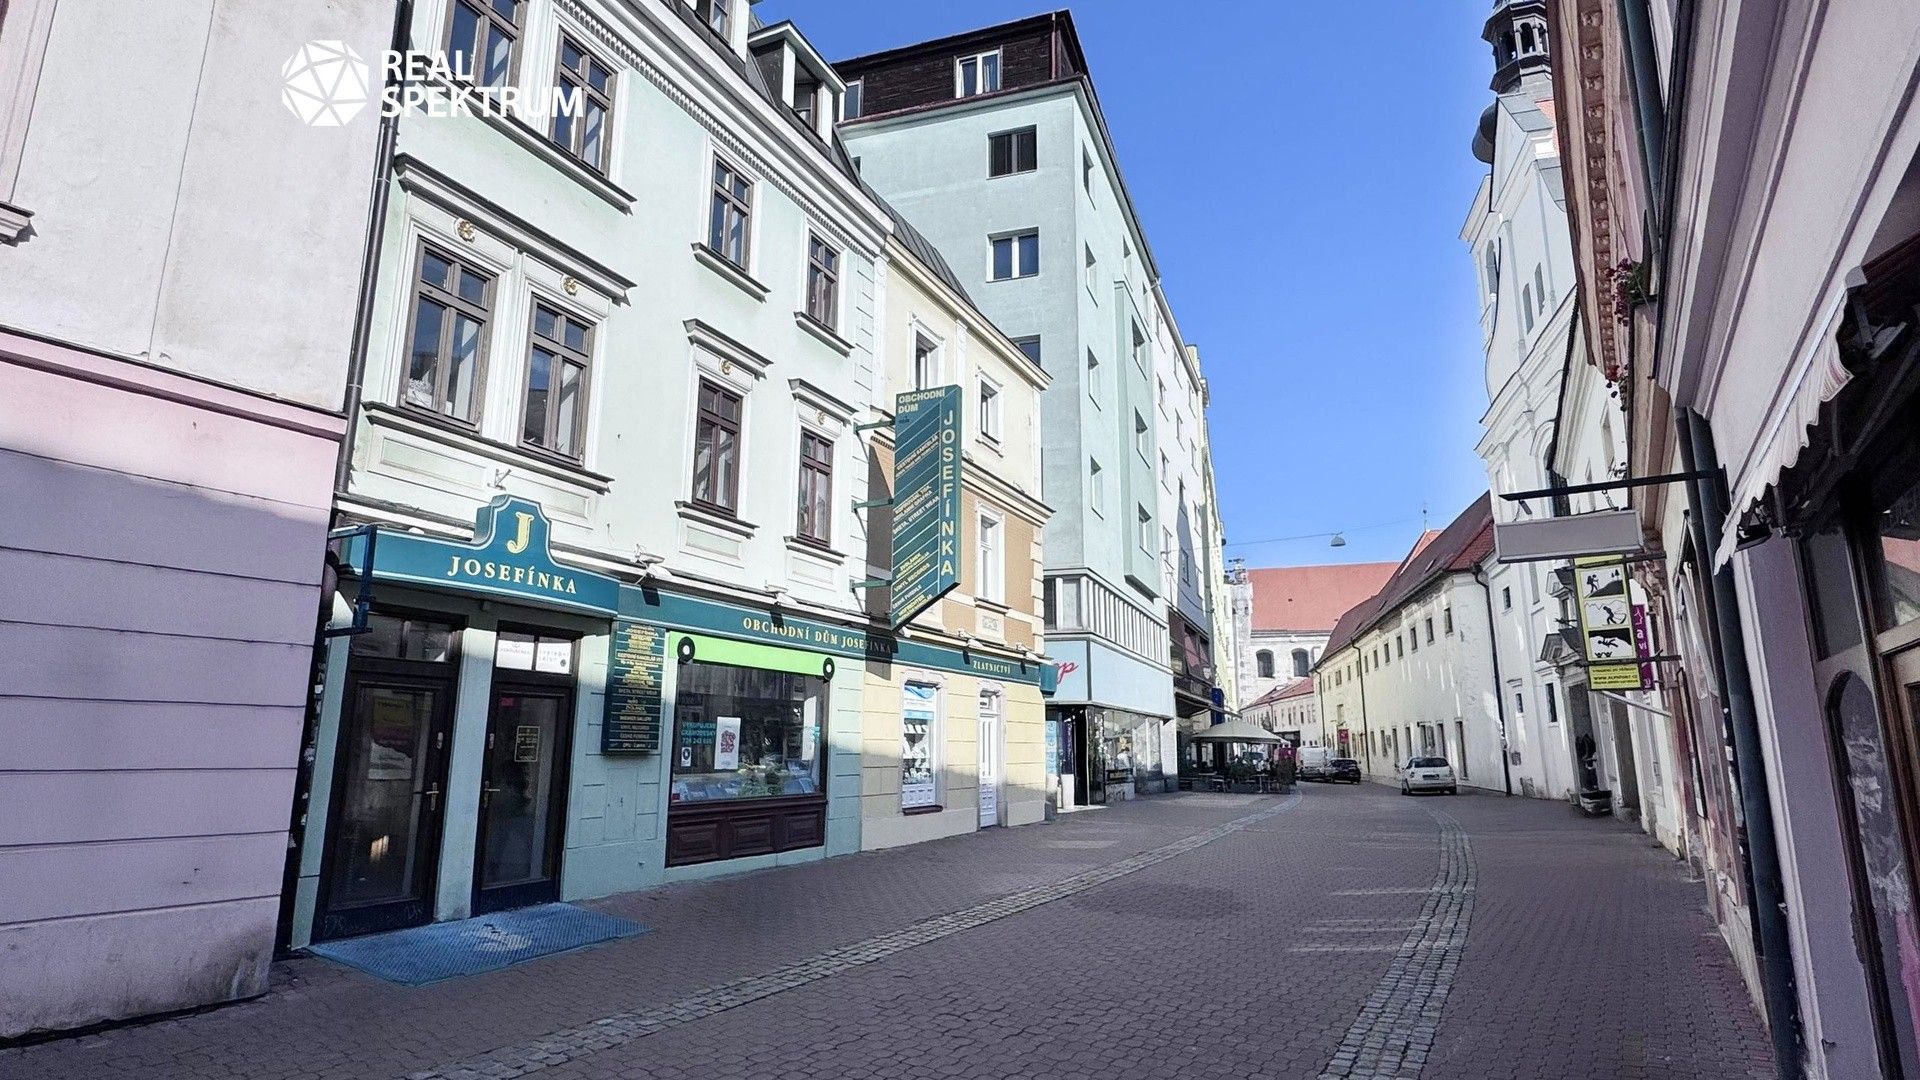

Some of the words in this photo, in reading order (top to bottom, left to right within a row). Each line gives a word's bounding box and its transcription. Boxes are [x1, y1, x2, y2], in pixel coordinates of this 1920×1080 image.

[898, 388, 945, 404] OBCHODNÍ
[898, 403, 919, 414] DŮM
[941, 409, 956, 577] JOSEFÍNKA
[506, 511, 535, 554] J
[447, 556, 577, 595] JOSEFÍNKA
[907, 563, 930, 582] RECORDS
[743, 617, 810, 641] OBCHODNÍ
[814, 628, 838, 645] DŮM
